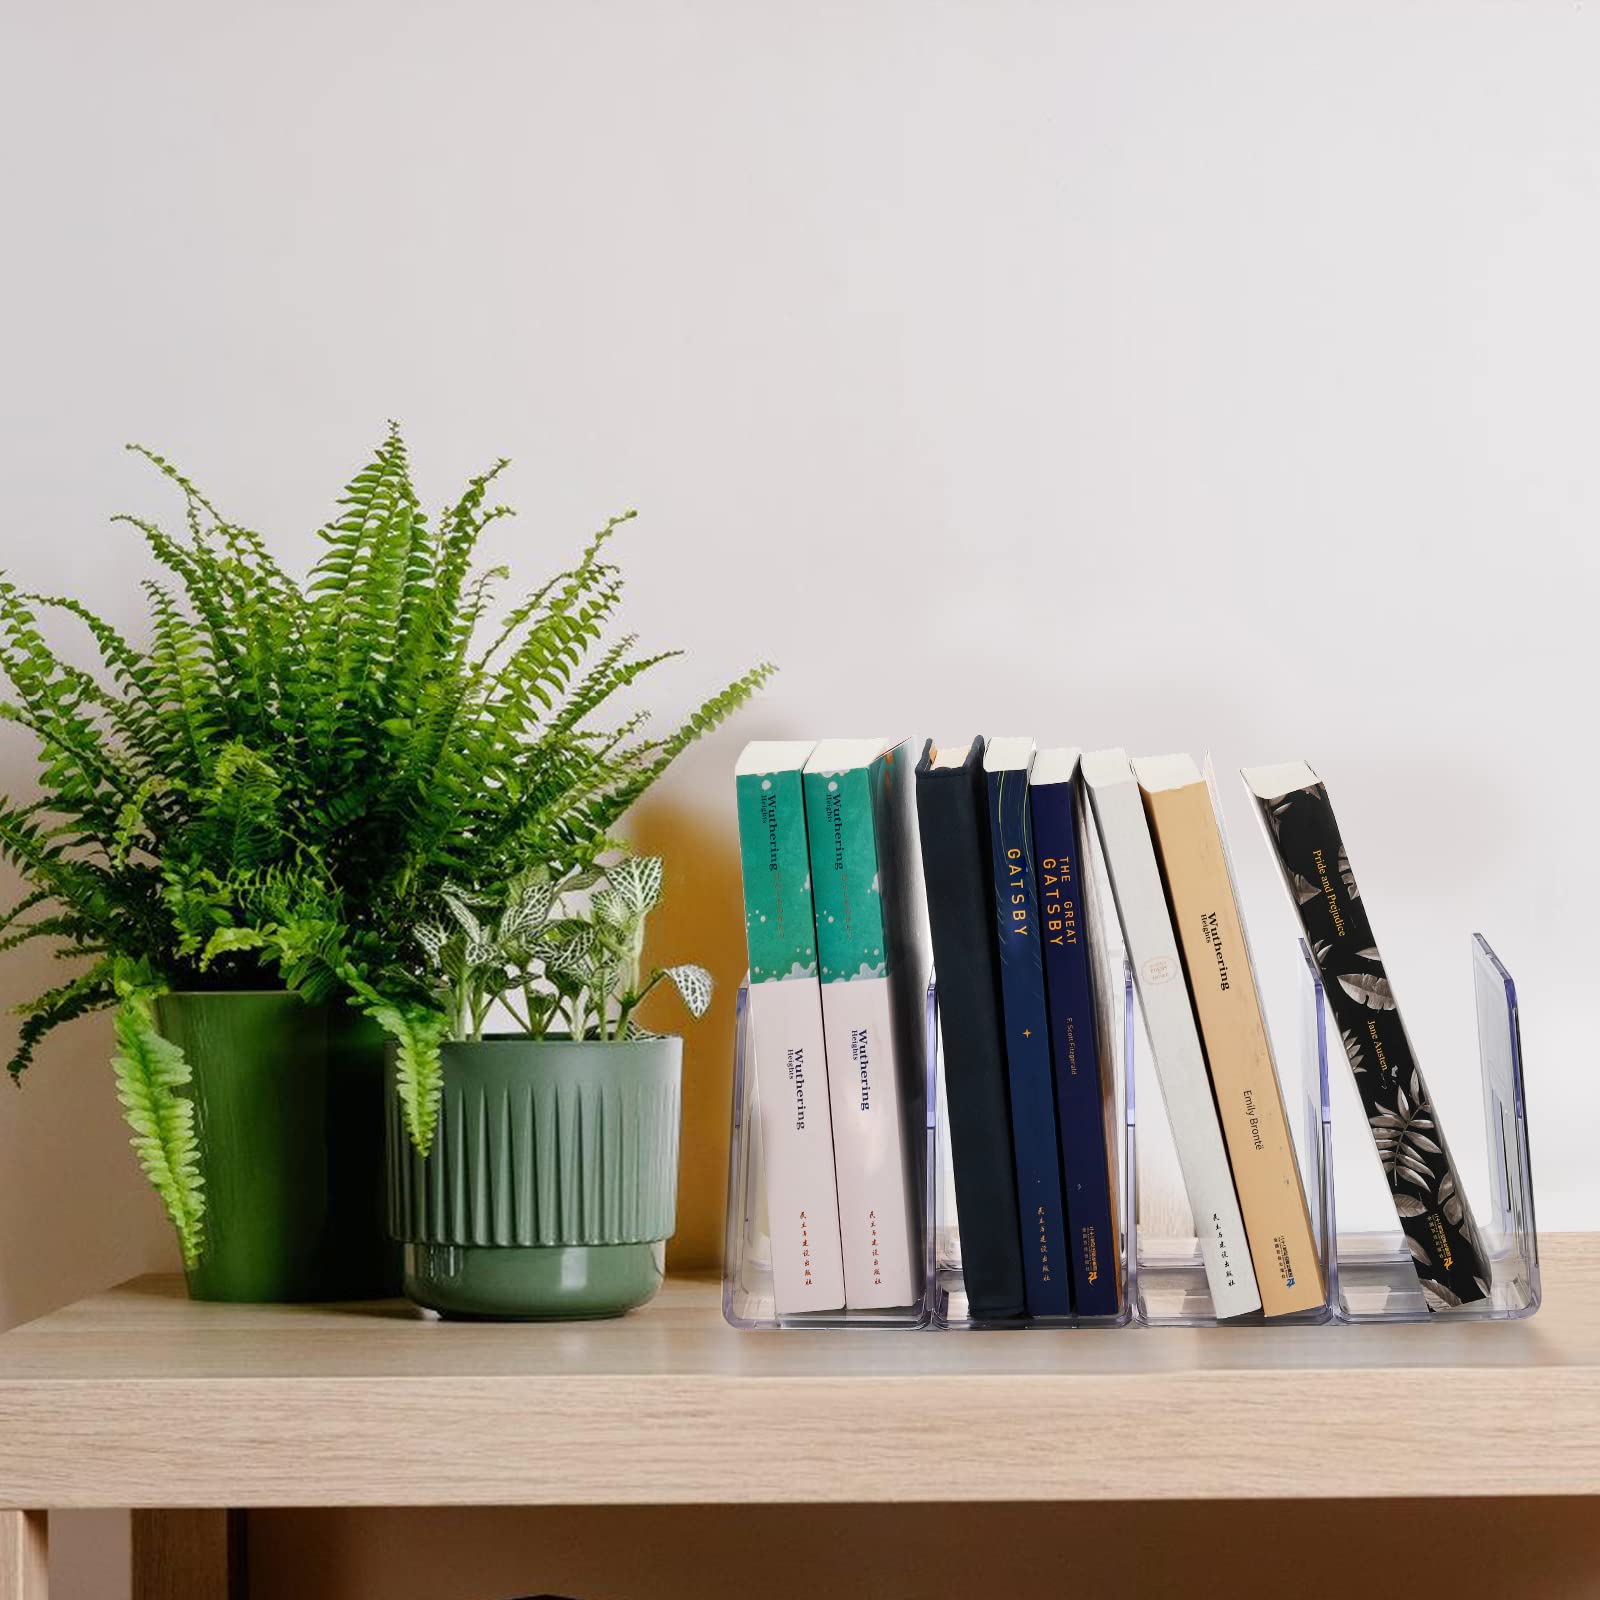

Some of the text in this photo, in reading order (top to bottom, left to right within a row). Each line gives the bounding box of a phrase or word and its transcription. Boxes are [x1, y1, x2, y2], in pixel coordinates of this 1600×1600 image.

[768, 794, 779, 872] Wuthering
[832, 793, 845, 871] Wuthering
[1007, 848, 1028, 936] GATSBY
[1043, 858, 1064, 946] GATSBY
[1059, 856, 1077, 944] THE GREAT
[1200, 913, 1211, 944] Heights
[1312, 849, 1346, 937] Pride and Prejudice
[1208, 912, 1230, 991] Wuthering
[786, 1049, 794, 1080] Heights
[851, 1029, 859, 1061] Heights
[858, 1028, 870, 1111] Wuthering
[1367, 1020, 1388, 1071] Jane Austen
[794, 1048, 806, 1131] Wuthering
[1243, 1089, 1264, 1151] Emily Brontë
